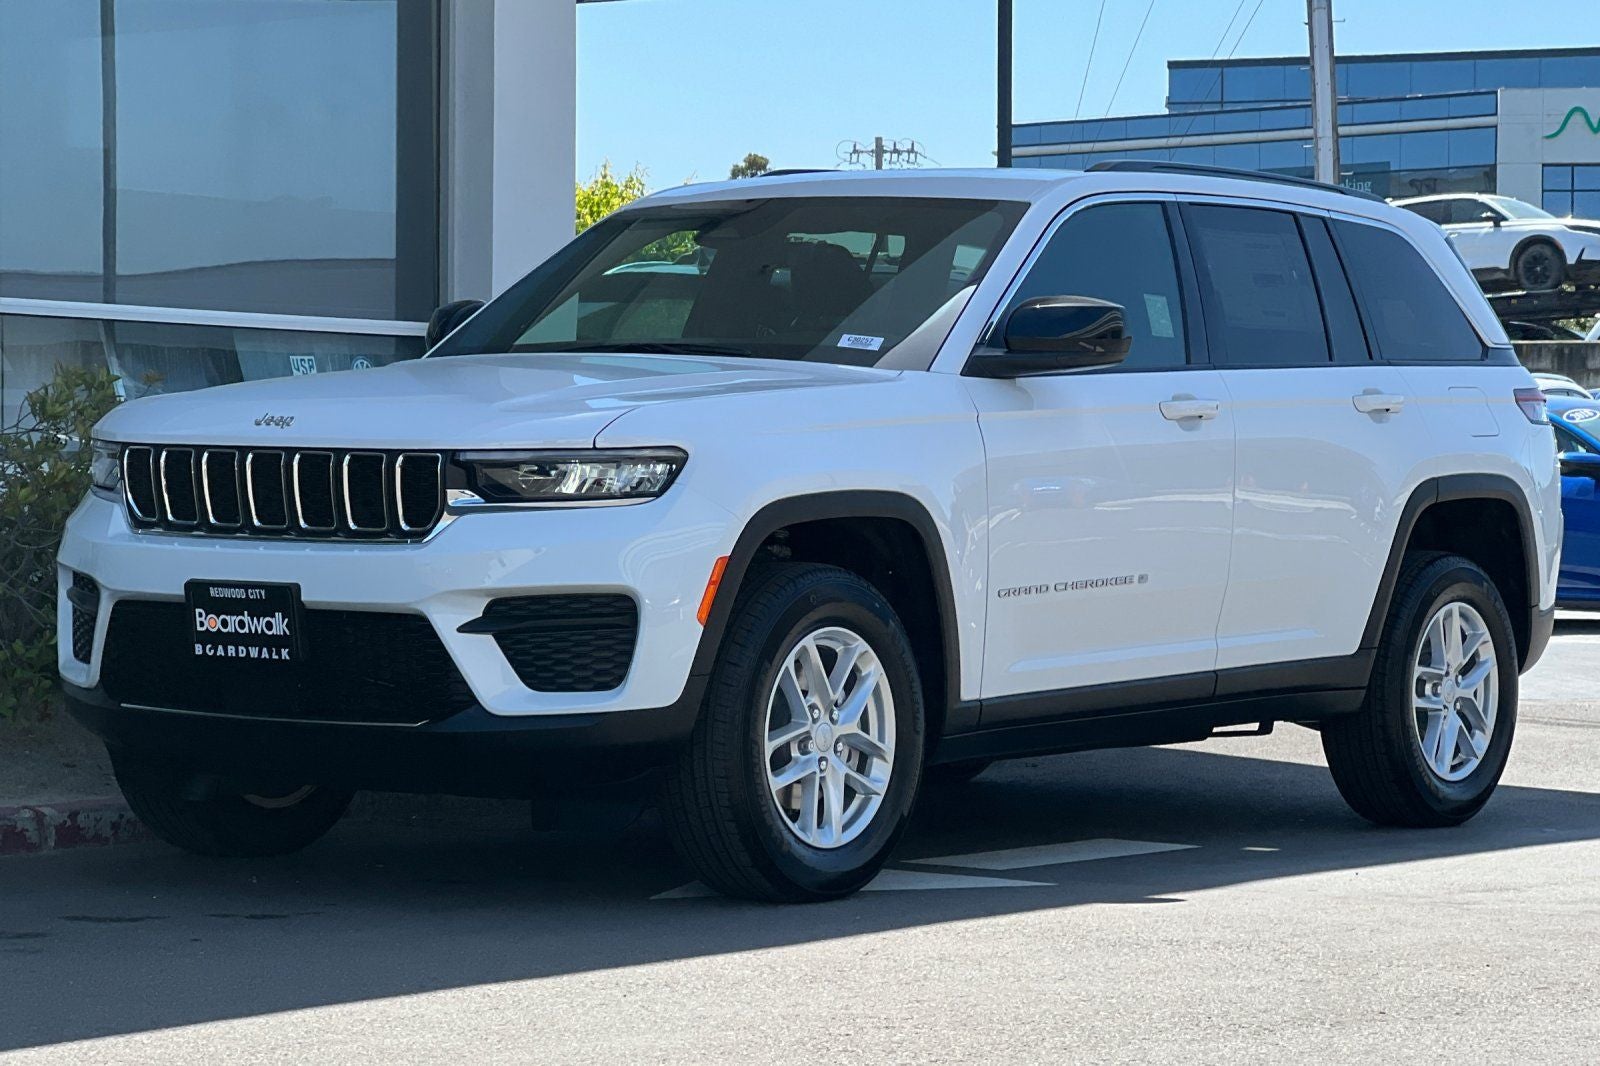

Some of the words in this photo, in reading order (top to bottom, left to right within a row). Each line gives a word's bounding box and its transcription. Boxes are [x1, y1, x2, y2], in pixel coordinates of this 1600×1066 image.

[255, 412, 294, 429] Jeep
[209, 586, 246, 599] REDWOOD
[248, 588, 265, 600] CITY
[997, 583, 1049, 599] GRAND
[1053, 574, 1135, 593] CHEROKEE
[195, 608, 290, 635] Boardwalk
[194, 643, 290, 660] BOARDWALK
